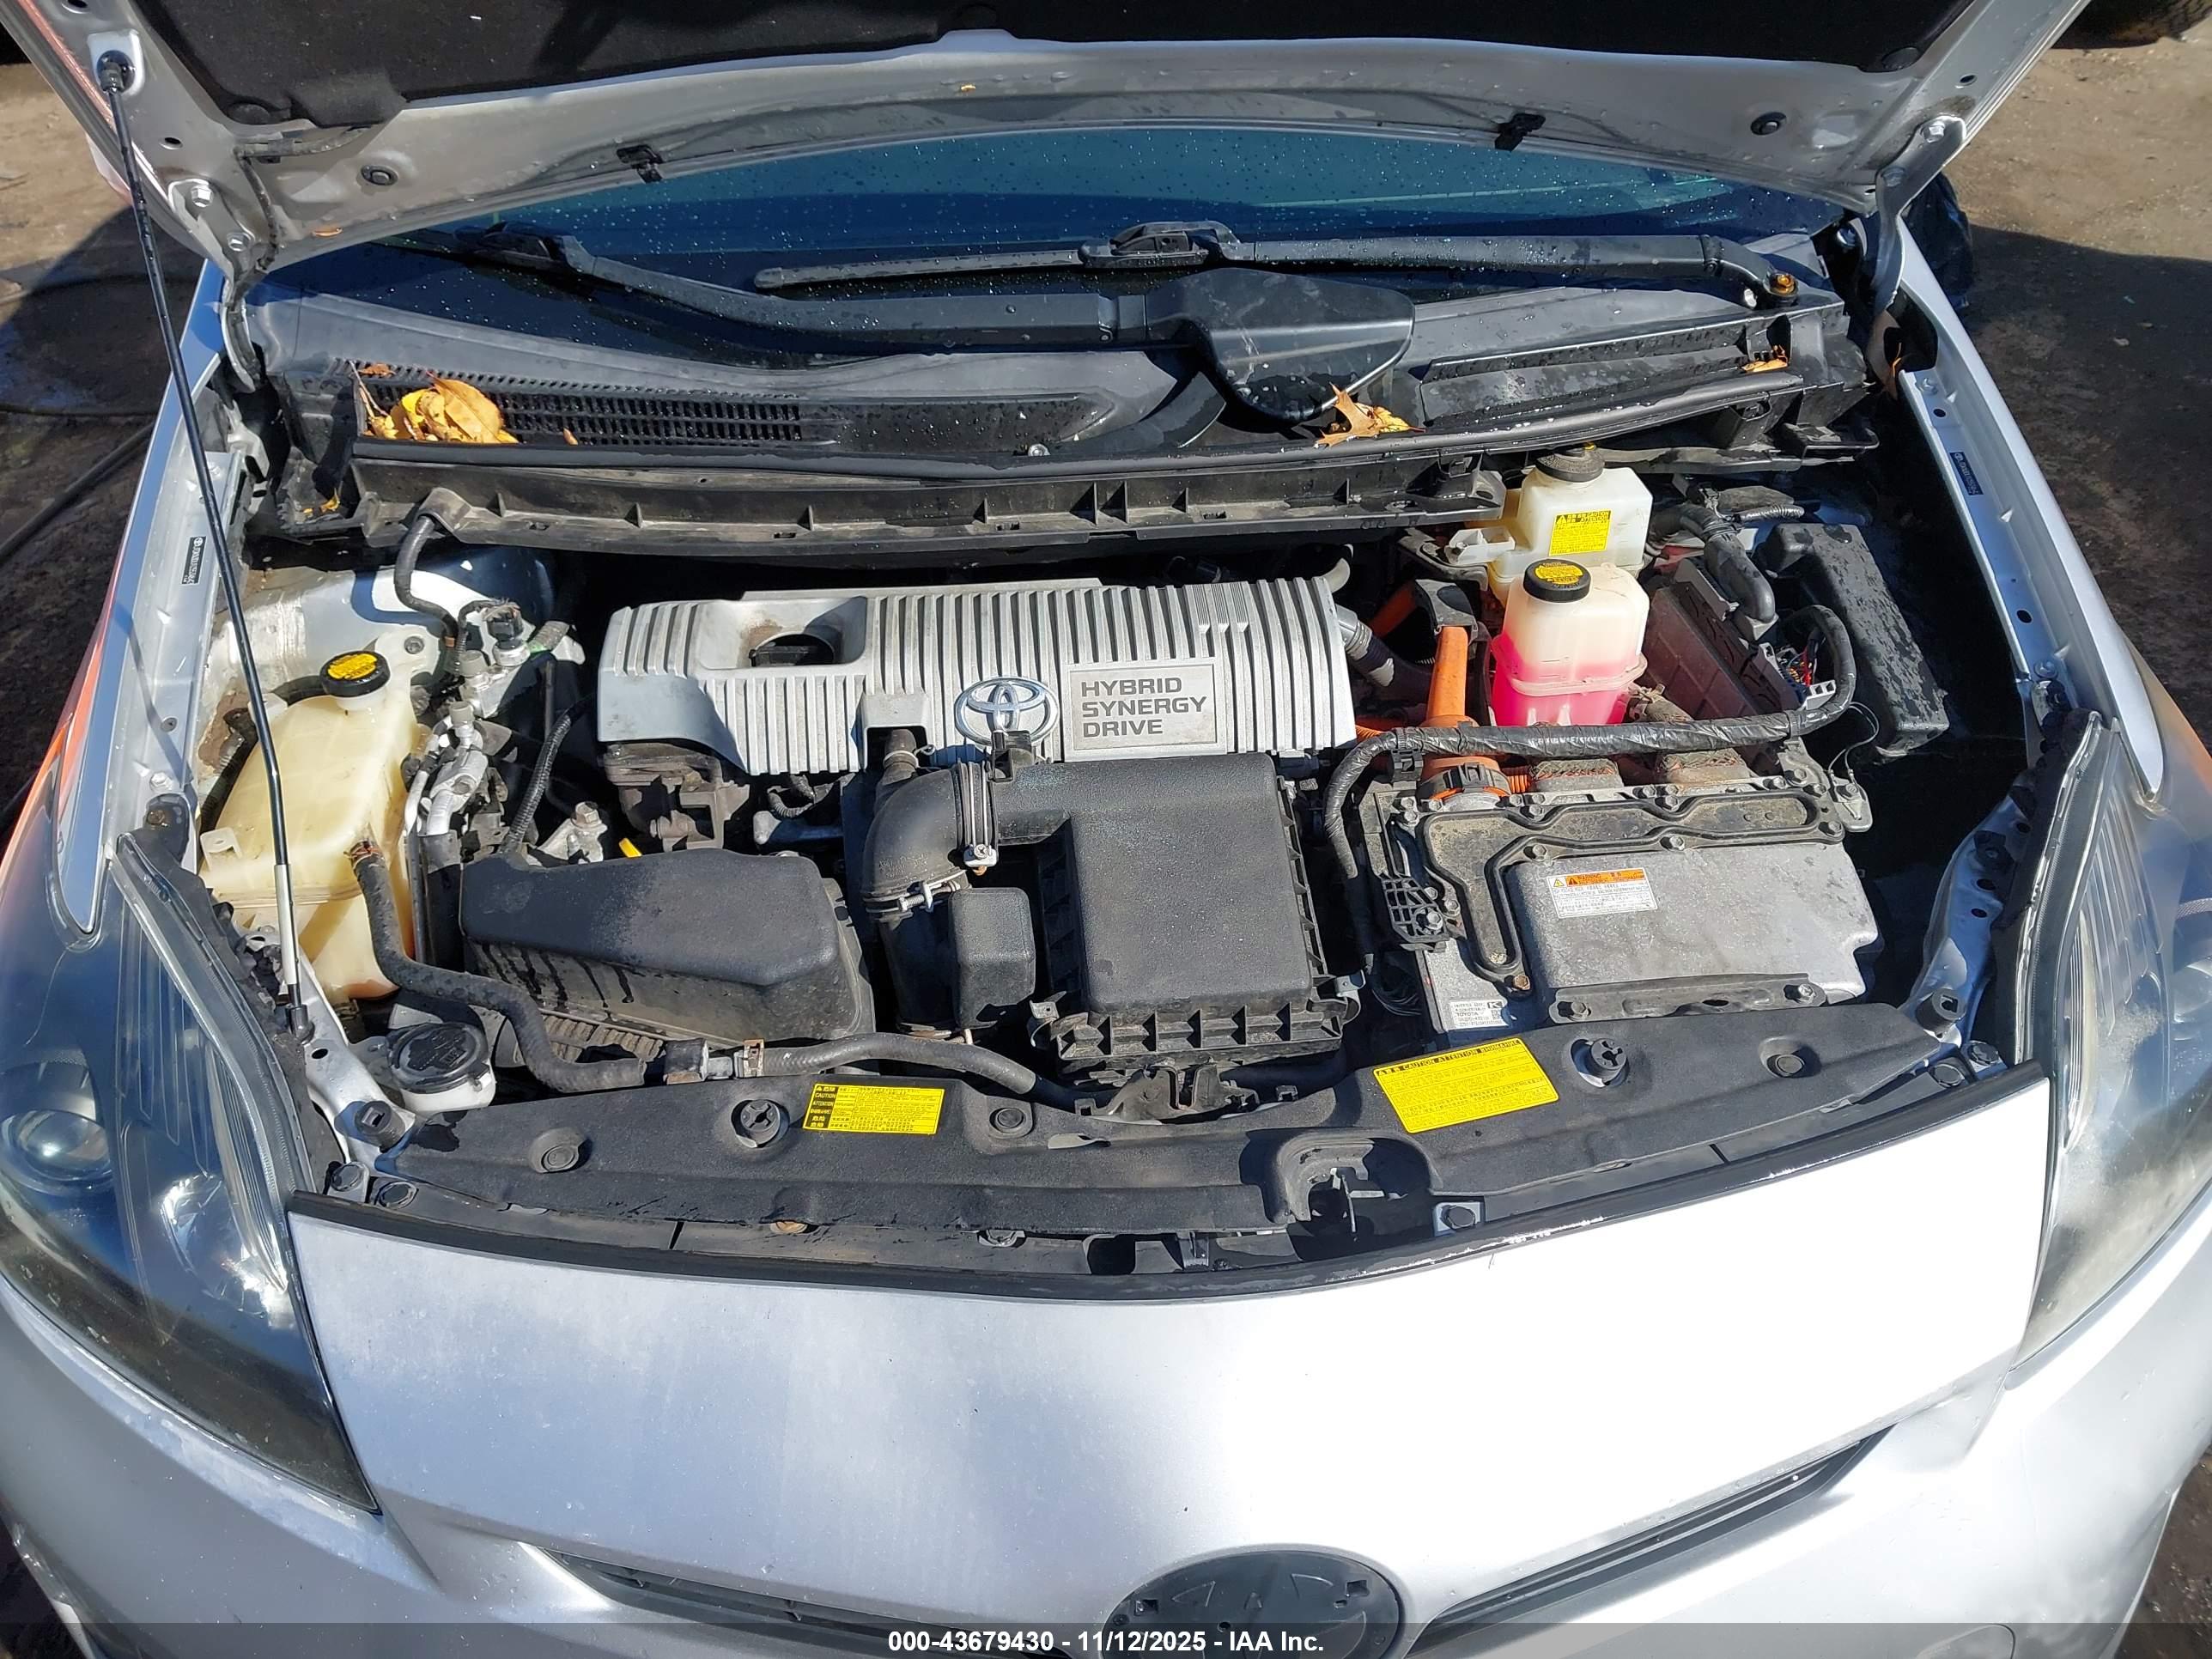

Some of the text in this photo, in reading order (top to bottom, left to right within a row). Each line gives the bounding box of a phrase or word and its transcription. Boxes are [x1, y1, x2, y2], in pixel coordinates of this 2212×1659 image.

[1081, 677, 1182, 697] HYBRID
[1082, 696, 1207, 718] SYNERGY
[1083, 719, 1164, 738] DRIVE
[1403, 1059, 1434, 1070] CAUTION
[1438, 1049, 1477, 1062] ATTENTION
